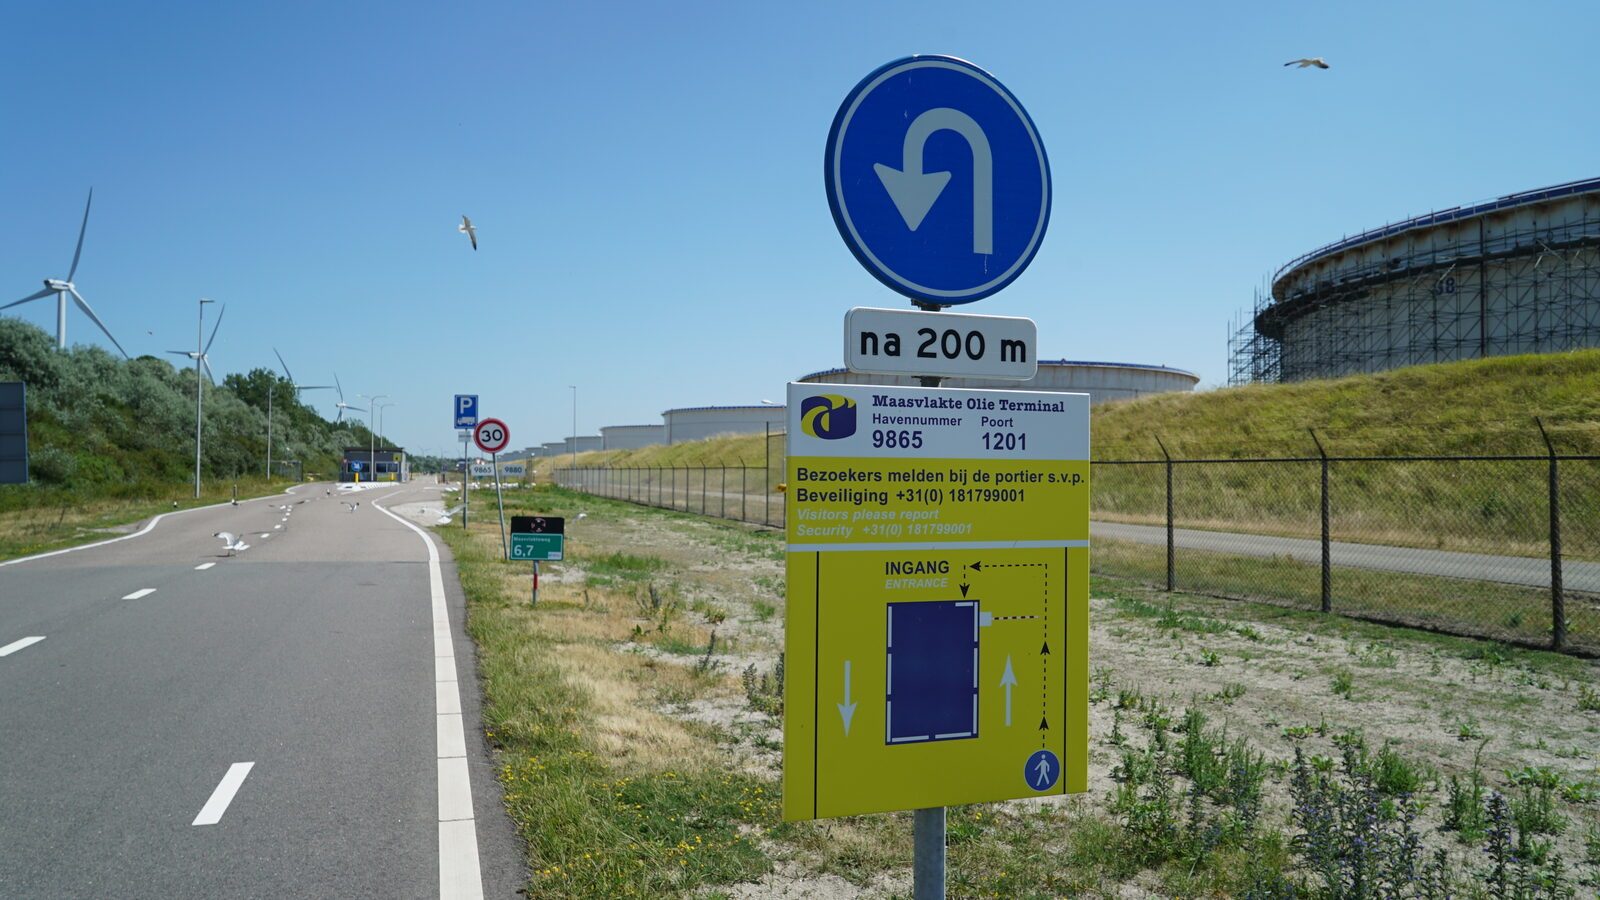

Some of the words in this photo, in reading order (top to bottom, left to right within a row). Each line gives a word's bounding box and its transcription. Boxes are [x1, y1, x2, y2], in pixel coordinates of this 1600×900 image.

[860, 331, 901, 357] na
[917, 328, 986, 360] 200
[1000, 338, 1027, 363] m
[460, 398, 473, 414] P
[872, 395, 963, 410] Maasvlakte
[966, 397, 995, 411] Olie
[999, 399, 1065, 413] Terminal
[872, 413, 962, 426] Havennummer
[981, 416, 1014, 427] Poort
[481, 429, 503, 442] 30
[872, 430, 923, 449] 9865
[981, 432, 1027, 450] 1201
[796, 468, 882, 482] Bezoekers
[888, 469, 944, 483] melden
[949, 469, 967, 485] bij
[972, 469, 990, 483] de
[995, 470, 1043, 486] portier
[1048, 472, 1085, 486] s.v.p.
[796, 488, 888, 505] Beveiliging
[895, 488, 944, 505] +31(0)
[949, 489, 1025, 502] 181799001
[796, 509, 848, 521] Visitors
[852, 509, 896, 523] please
[900, 509, 940, 522] report
[796, 524, 853, 538] Security
[862, 524, 903, 538] +31(0)
[907, 524, 972, 535] 181799001
[885, 560, 950, 576] INGANG
[884, 577, 949, 590] ENTRANCE
